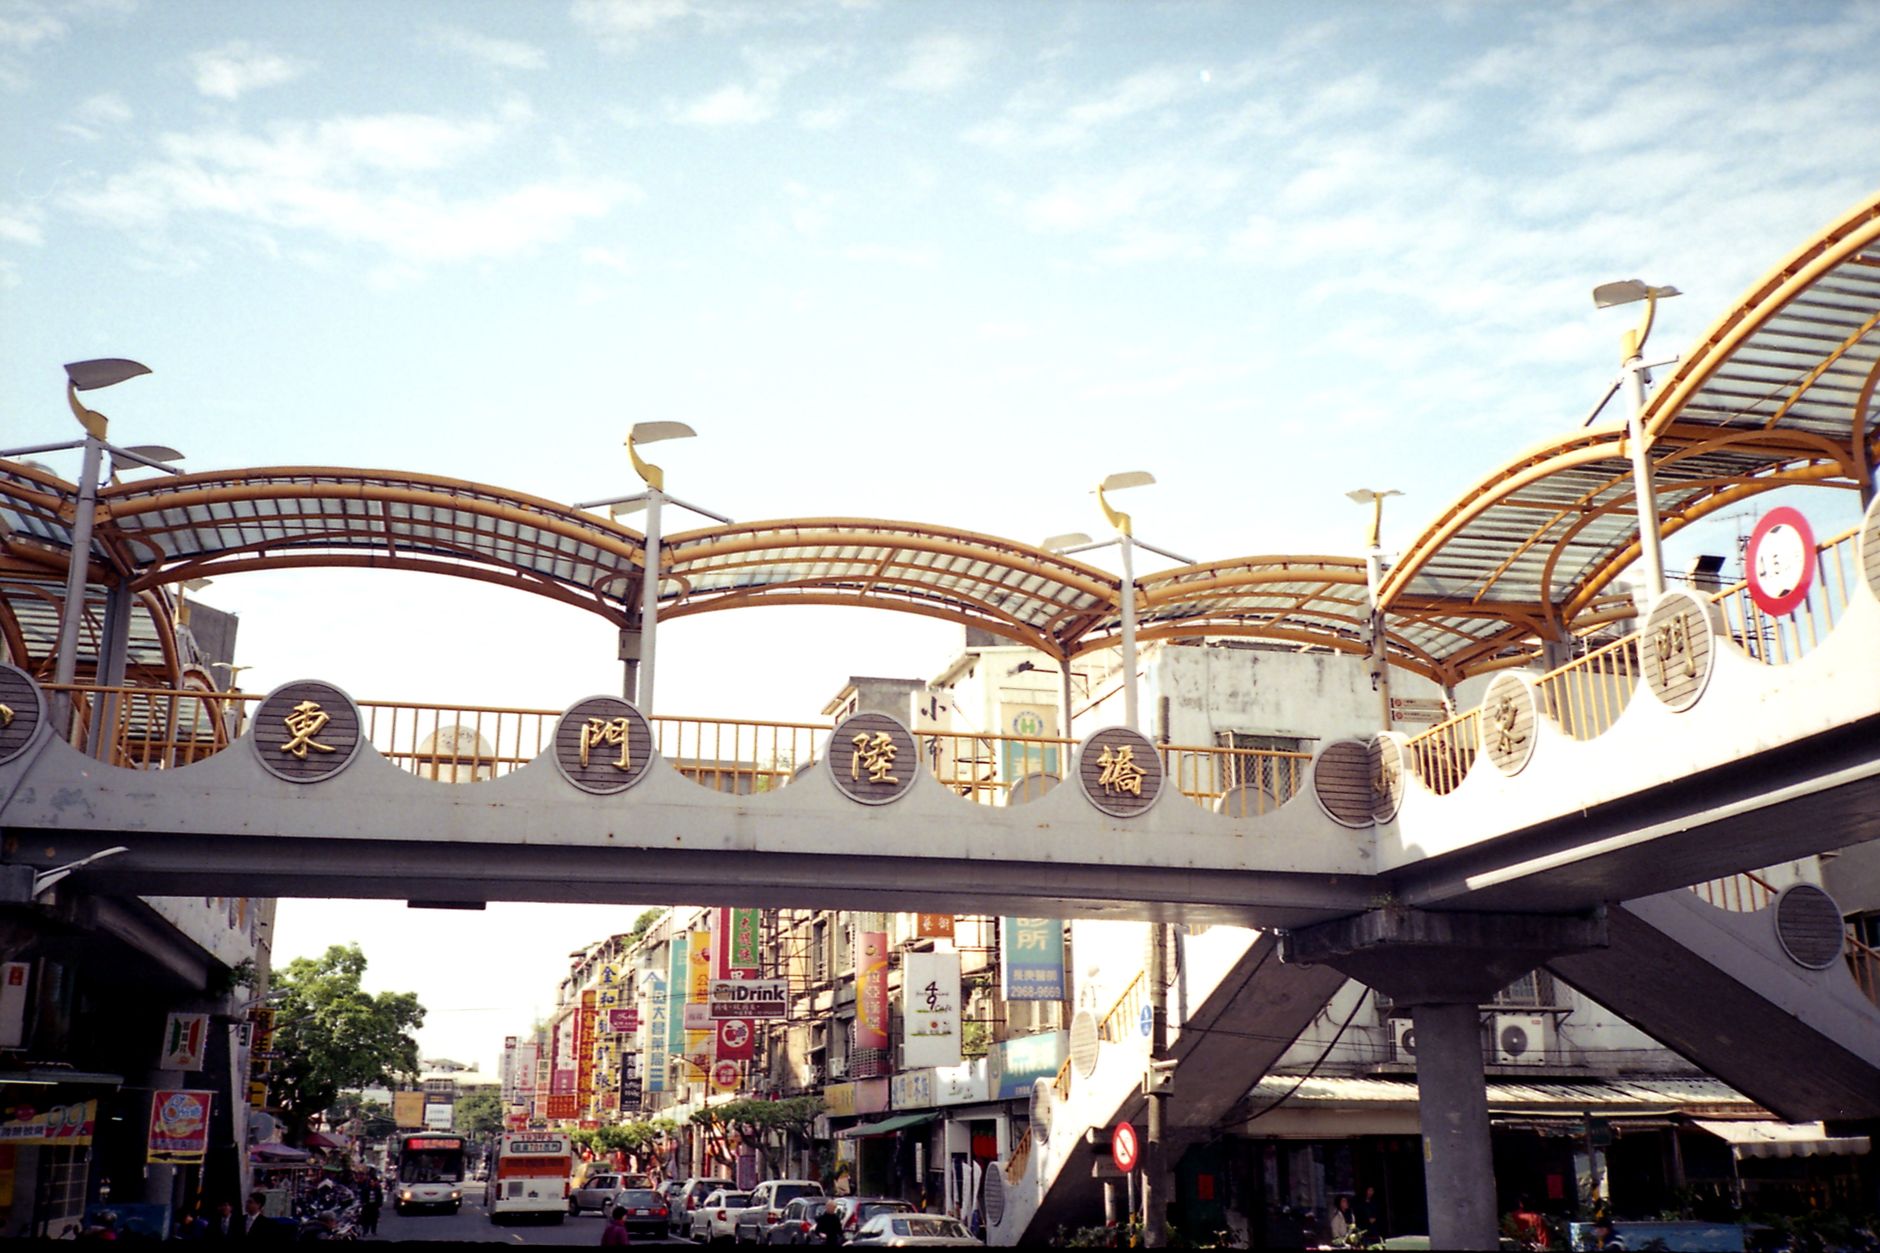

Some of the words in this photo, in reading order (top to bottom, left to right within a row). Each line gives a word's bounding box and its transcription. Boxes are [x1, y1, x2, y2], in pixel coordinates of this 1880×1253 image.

[1655, 611, 1696, 687] 門
[281, 700, 336, 760] 東
[580, 717, 631, 771] 門
[852, 731, 899, 785] 陸
[1096, 744, 1147, 797] 橋
[731, 984, 785, 1002] iDrink
